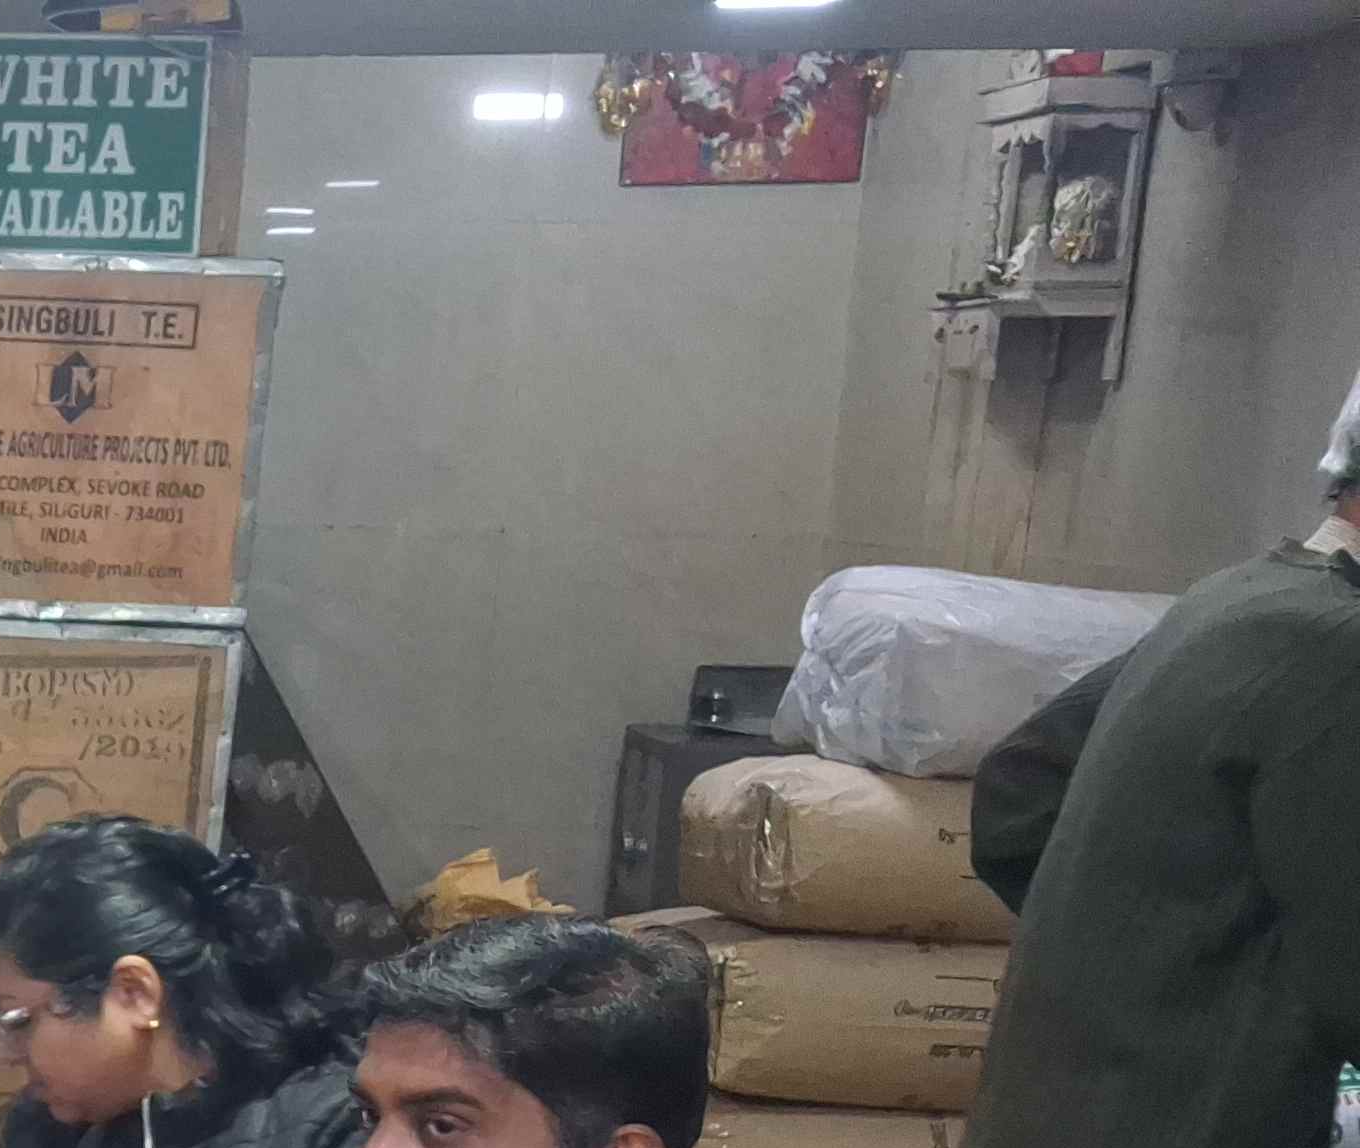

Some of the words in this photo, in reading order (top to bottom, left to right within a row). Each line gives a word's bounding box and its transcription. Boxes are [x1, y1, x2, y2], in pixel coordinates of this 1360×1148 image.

[0, 122, 135, 176] TEA
[141, 311, 185, 339] T.E.
[7, 431, 98, 460] AGRICULTURE
[102, 437, 169, 464] PROJECTS
[88, 478, 150, 496] SEVOKE
[156, 480, 205, 498] ROAD
[39, 502, 110, 520] SILIGURI
[125, 505, 184, 523] 734001
[40, 527, 87, 544] INDIA
